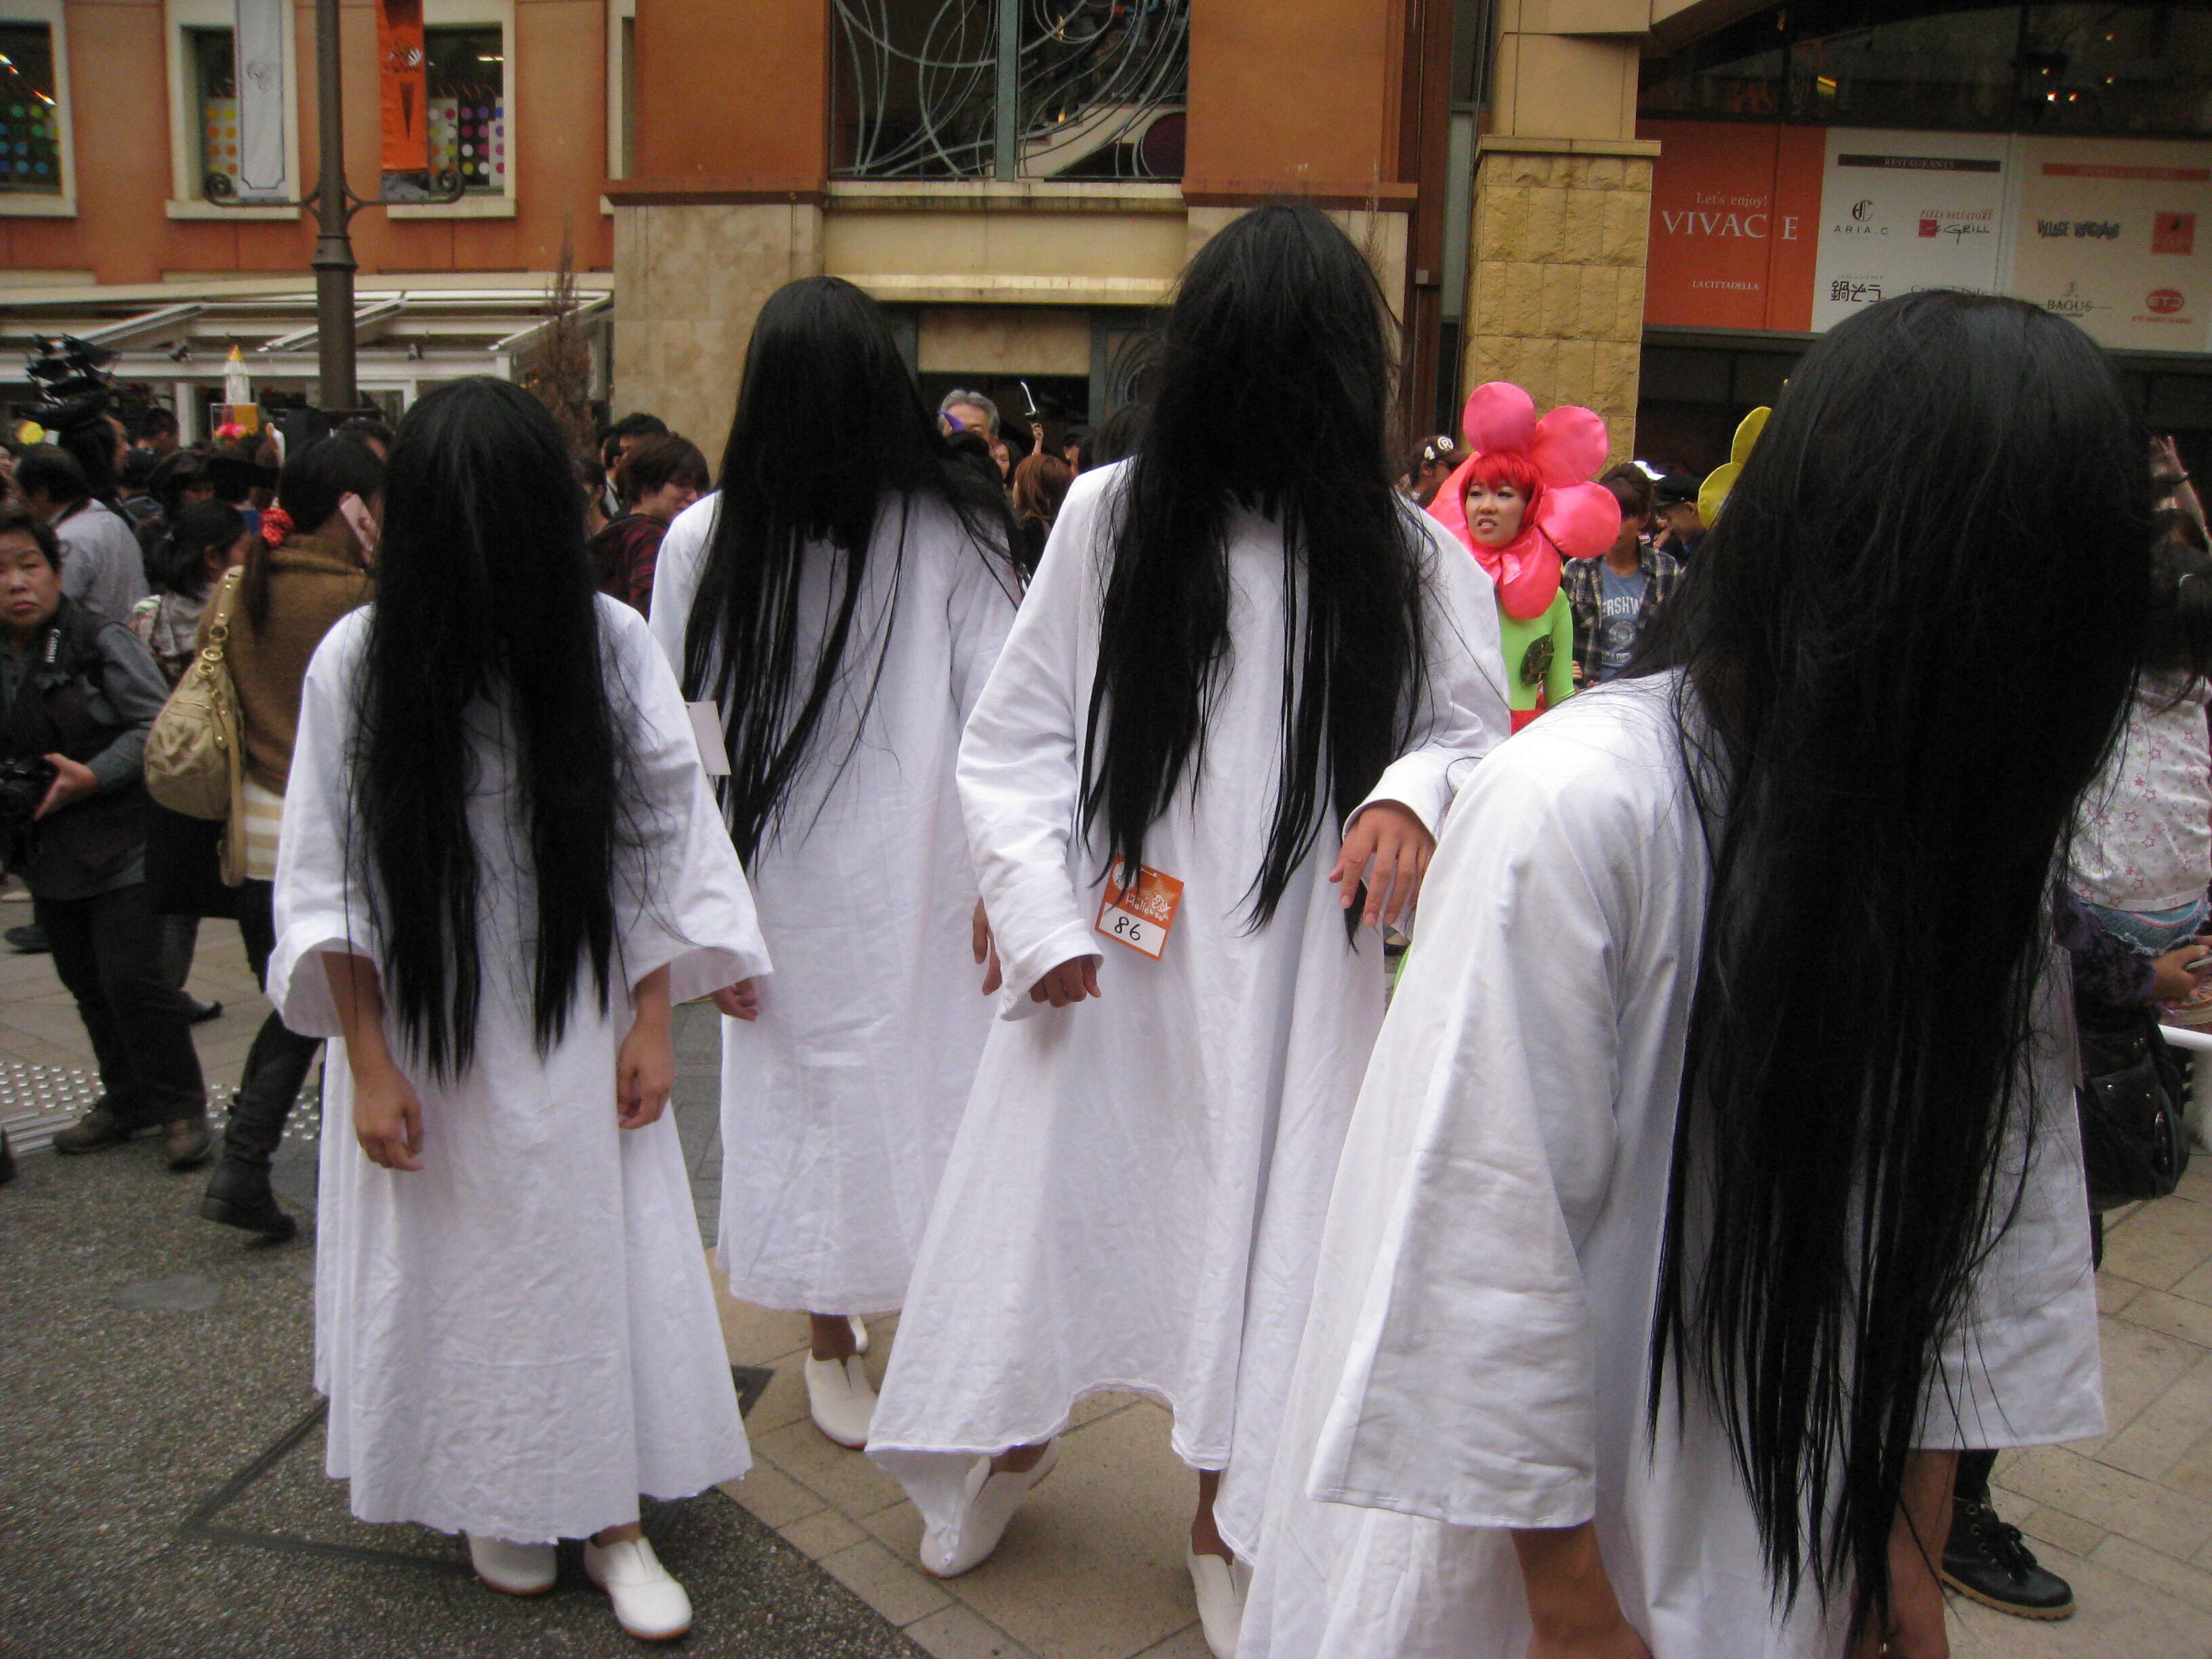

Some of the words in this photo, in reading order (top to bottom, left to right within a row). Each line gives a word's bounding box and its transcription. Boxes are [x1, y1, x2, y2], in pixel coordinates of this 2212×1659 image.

[1696, 192, 1725, 203] Let's
[1731, 194, 1767, 208] enjoy!
[1114, 917, 1141, 941] 86
